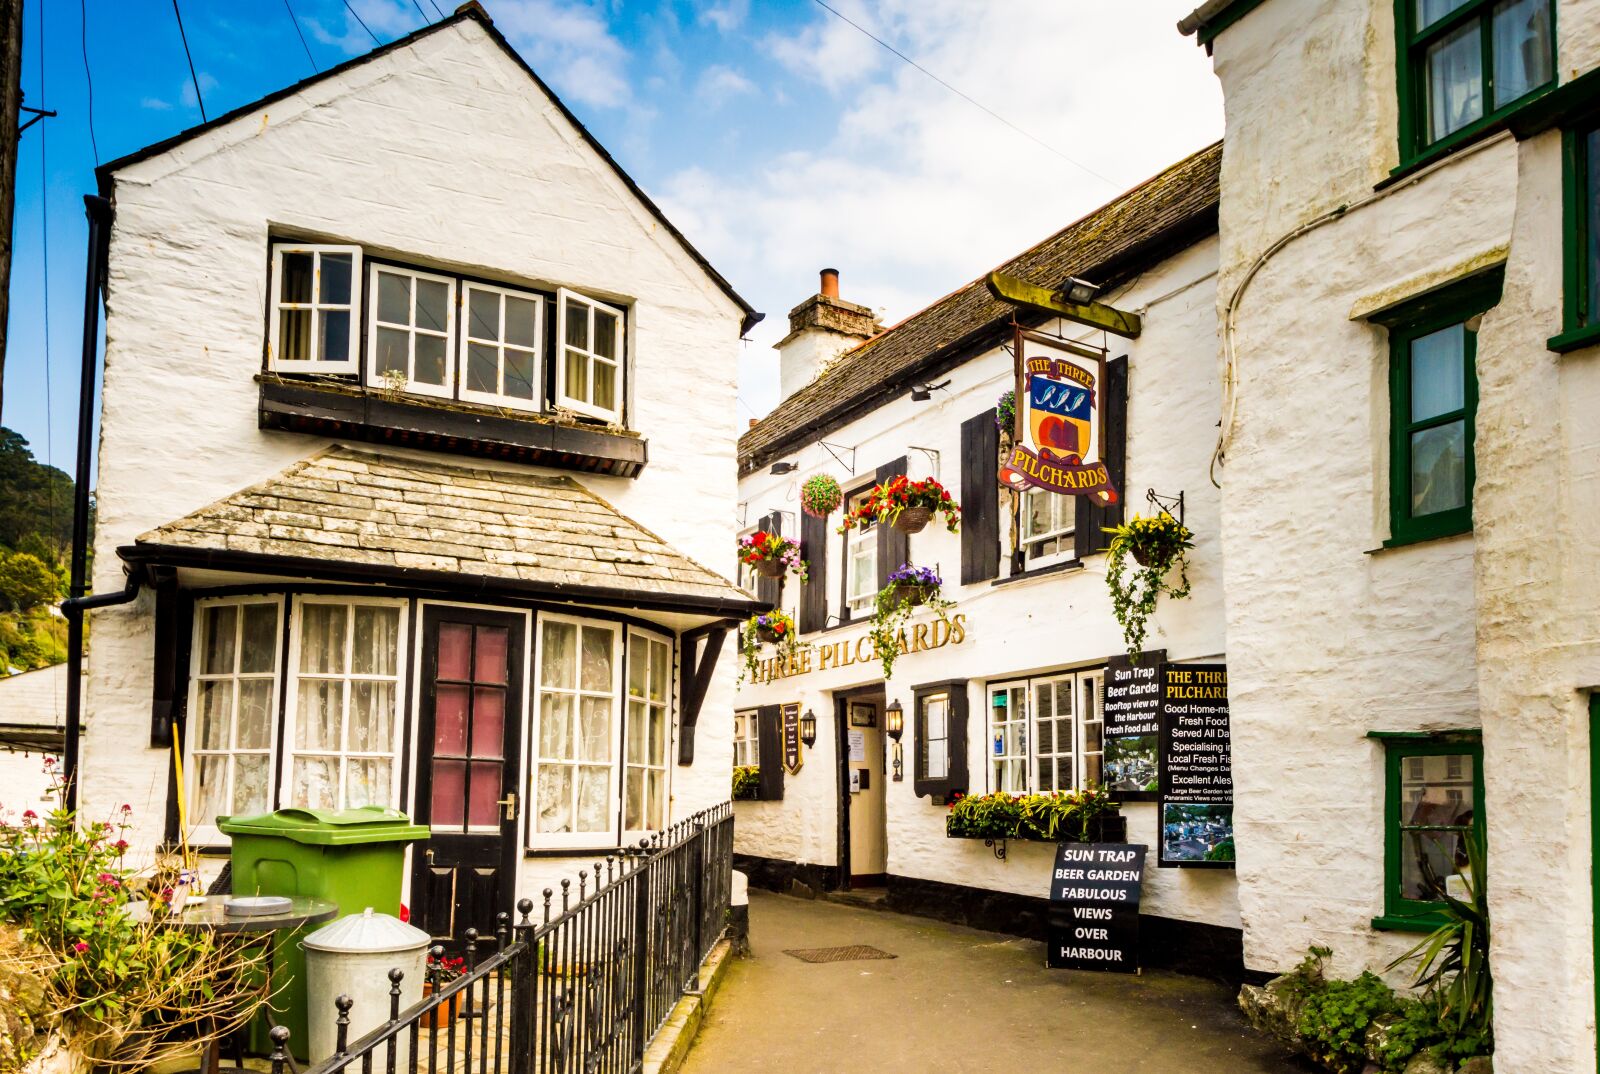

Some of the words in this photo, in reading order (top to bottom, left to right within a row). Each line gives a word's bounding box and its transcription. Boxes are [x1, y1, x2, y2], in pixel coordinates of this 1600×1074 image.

[1029, 359, 1051, 372] THE
[1058, 362, 1093, 387] THREE
[1012, 449, 1107, 489] PILCHARDS
[1115, 670, 1132, 680] Sun
[1133, 667, 1154, 680] Trap
[1166, 671, 1192, 684] THE
[1108, 686, 1128, 698] Beer
[1105, 701, 1132, 711] Rooftop
[1132, 700, 1149, 708] view
[1164, 704, 1188, 714] Good
[1190, 705, 1230, 714] Home-ma
[1114, 713, 1126, 722] the
[1126, 712, 1156, 721] Harbour
[1179, 716, 1203, 726] Fresh
[1206, 717, 1228, 726] Food
[1106, 725, 1124, 734] Fresh
[1124, 724, 1140, 734] Food
[1142, 723, 1150, 732] all
[1172, 728, 1202, 738] Served
[1204, 729, 1214, 738] All
[1218, 729, 1230, 738] Da
[1172, 742, 1223, 753] Specialising
[1168, 754, 1190, 763] Local
[1193, 754, 1218, 764] Fresh
[1220, 755, 1232, 764] Fis
[1172, 774, 1210, 784] Excellent
[1212, 776, 1232, 784] Ales
[1064, 850, 1094, 862] SUN
[1098, 850, 1136, 862] TRAP
[1055, 868, 1084, 880] BEER
[1087, 870, 1140, 881] GARDEN
[1062, 888, 1127, 900] FABULOUS
[1073, 907, 1112, 920] VIEWS
[1075, 928, 1108, 940] OVER
[1060, 946, 1122, 961] HARBOUR
